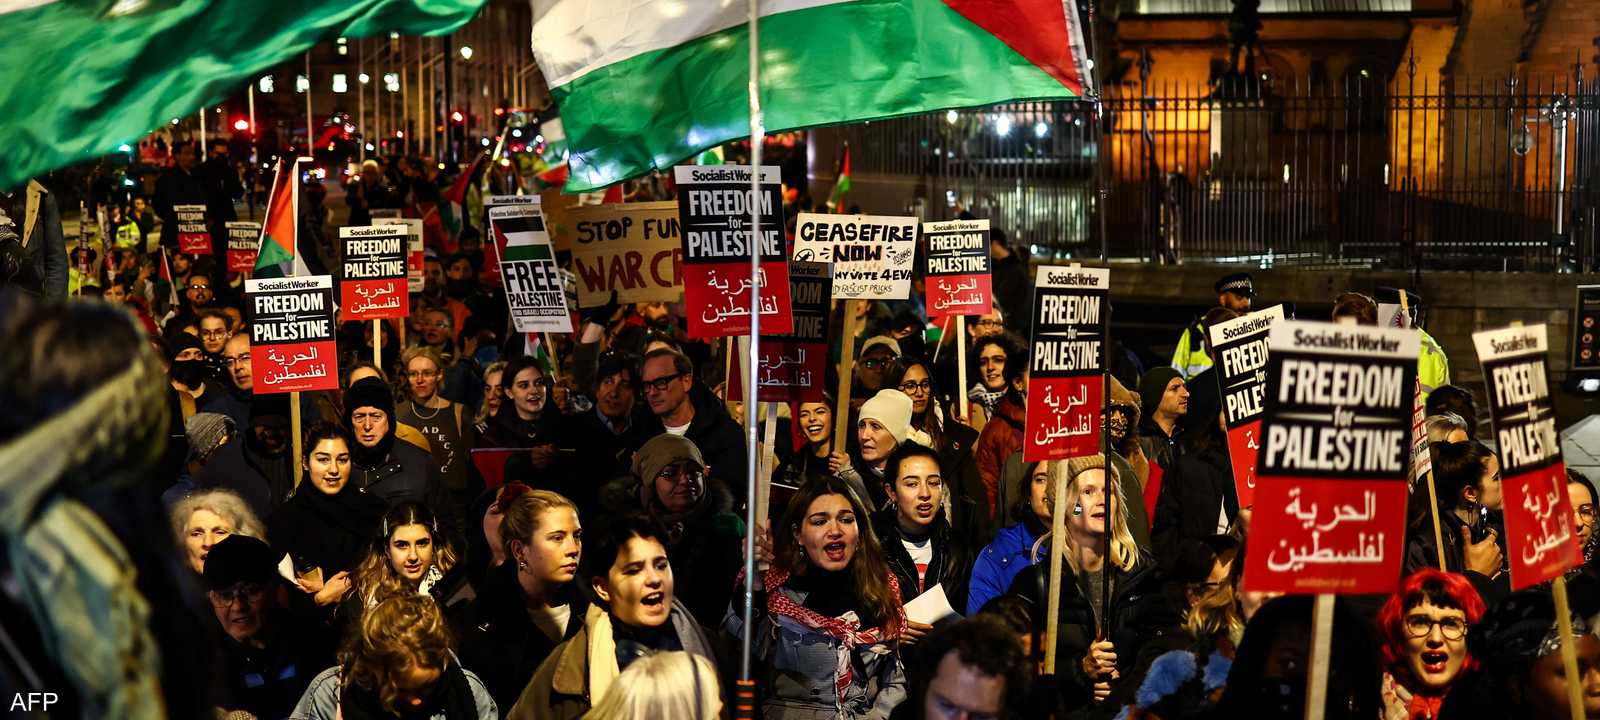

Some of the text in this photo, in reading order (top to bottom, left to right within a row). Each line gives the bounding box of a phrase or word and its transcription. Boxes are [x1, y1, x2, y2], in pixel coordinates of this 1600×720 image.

[692, 170, 766, 181] Socialist Worer
[576, 216, 681, 243] STOP FUN
[727, 216, 742, 230] for
[800, 222, 913, 242] CEASEFIRE
[346, 238, 400, 255] FREEDOM
[930, 233, 983, 251] FREEDOM
[370, 254, 380, 262] for
[833, 244, 882, 262] NOW
[344, 260, 404, 278] PALESTINE
[575, 251, 647, 292] WAR
[928, 256, 987, 273] PALESTINE
[258, 280, 319, 290] Socialist Worker
[501, 261, 560, 292] FREE
[938, 277, 977, 294] الحرية
[355, 282, 394, 299] الحرية
[508, 292, 564, 307] PALESTINE
[934, 292, 984, 309] لفلسطين
[254, 293, 324, 314] FREEDOM
[350, 296, 400, 313] لفلسطين
[1040, 295, 1100, 325] FREEDOM
[285, 312, 297, 321] for
[253, 320, 330, 342] PALESTINE
[1067, 325, 1077, 340] for
[1222, 321, 1255, 340] Socialist
[1294, 329, 1400, 352] Socialist Worker
[268, 346, 318, 366] الحرية
[1034, 341, 1100, 371] PALESTINE
[264, 363, 327, 384] لفلسطين
[1279, 360, 1404, 407] FREEDOM
[1043, 384, 1087, 414] الحرية
[1334, 406, 1354, 427] for
[1035, 413, 1092, 445] لفلسطين
[1265, 425, 1404, 471] PALESTINE
[1285, 487, 1376, 531] الحرية
[1267, 530, 1384, 572] لفلسطين
